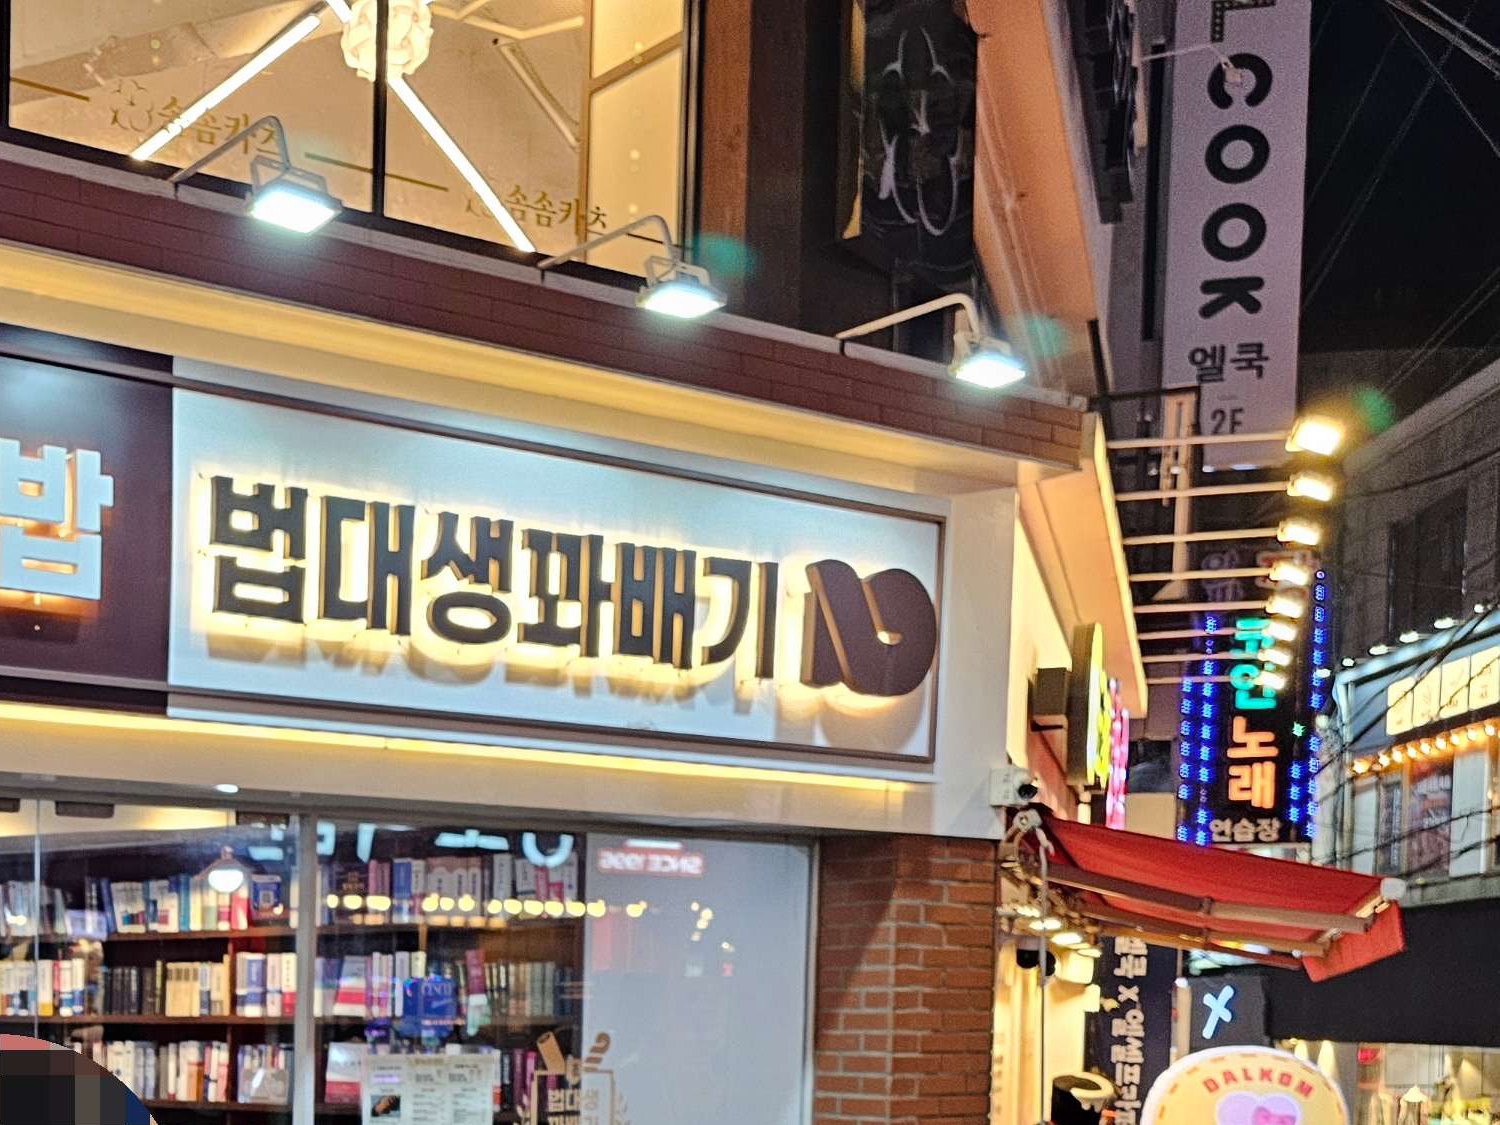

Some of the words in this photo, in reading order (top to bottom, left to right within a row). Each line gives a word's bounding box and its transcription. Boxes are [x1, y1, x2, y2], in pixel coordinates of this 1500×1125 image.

[1188, 342, 1269, 384] 엘쿡
[1211, 407, 1244, 435] 2F
[209, 474, 779, 680] 법대생꽈배기
[1209, 816, 1282, 843] 연습장
[1202, 1066, 1314, 1098] DALKOM
[547, 1087, 599, 1112] 법대생
